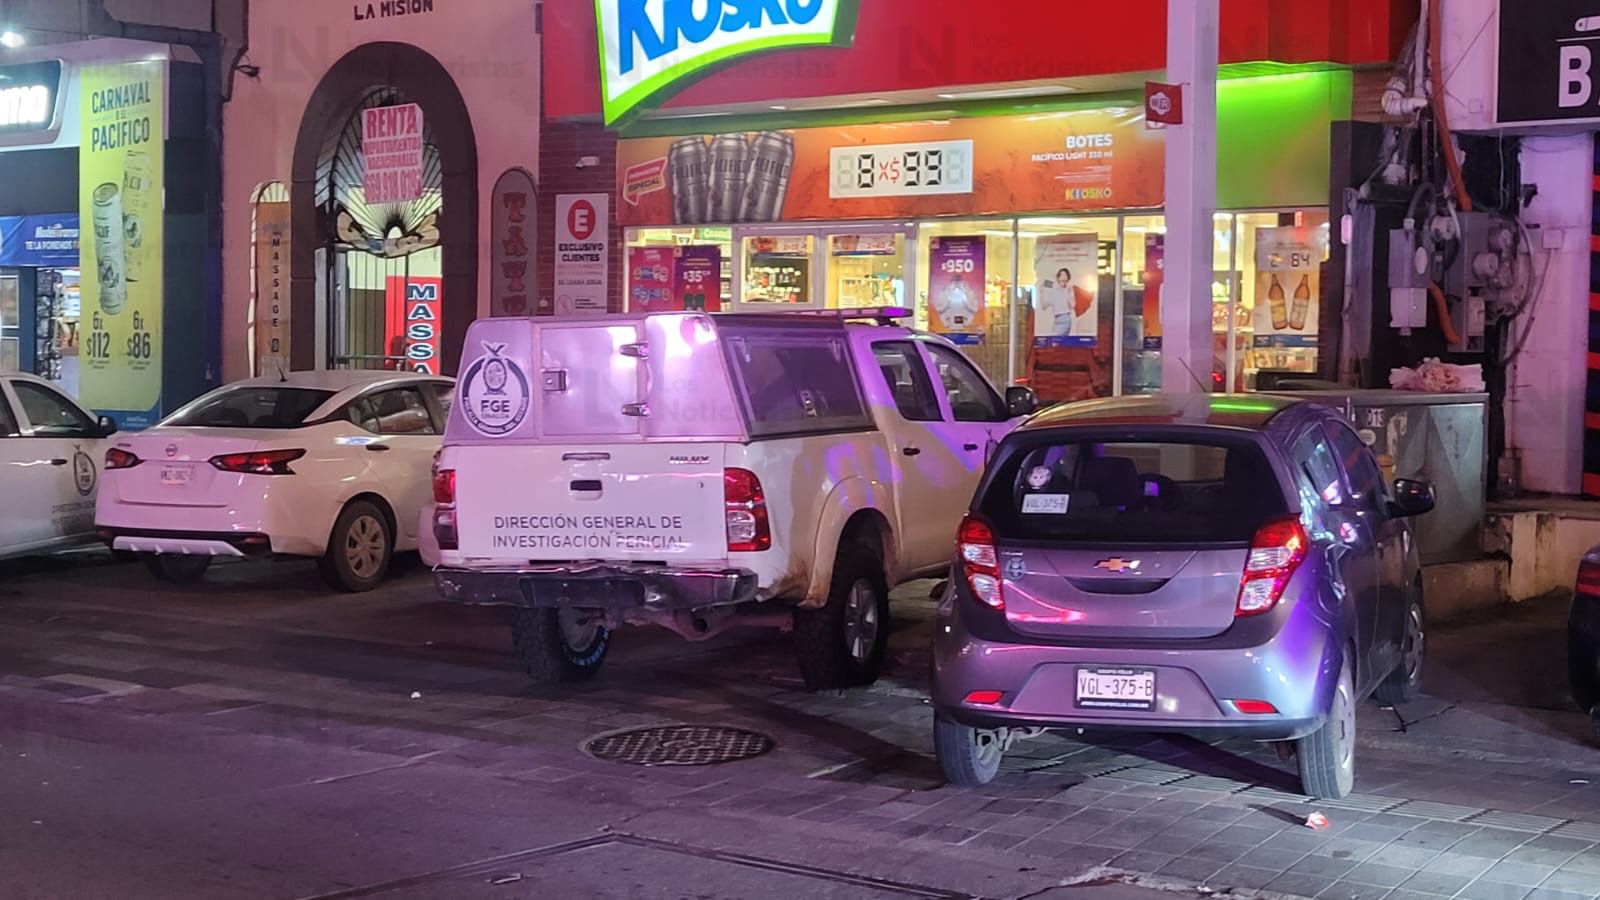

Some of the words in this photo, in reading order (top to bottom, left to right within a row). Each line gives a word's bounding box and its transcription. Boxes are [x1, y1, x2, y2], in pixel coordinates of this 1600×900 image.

[354, 4, 375, 21] LA
[1558, 45, 1600, 108] B
[92, 81, 151, 113] CARNAVAL
[367, 105, 418, 139] RENTA
[1066, 134, 1112, 148] BOTES
[575, 208, 588, 232] E
[558, 242, 604, 252] EXCLUSIVO
[561, 253, 600, 262] CLIENTES
[941, 259, 974, 273] $950
[271, 238, 280, 327] MASSAGE
[86, 332, 110, 357] $112
[127, 332, 151, 359] $86
[481, 400, 510, 412] FGE
[494, 513, 578, 529] DIRECCIÓN
[582, 516, 656, 529] GENERAL
[661, 516, 682, 529] DE
[492, 532, 611, 548] INVESTIGACIÓN
[1080, 677, 1152, 697] VGL-375-B
